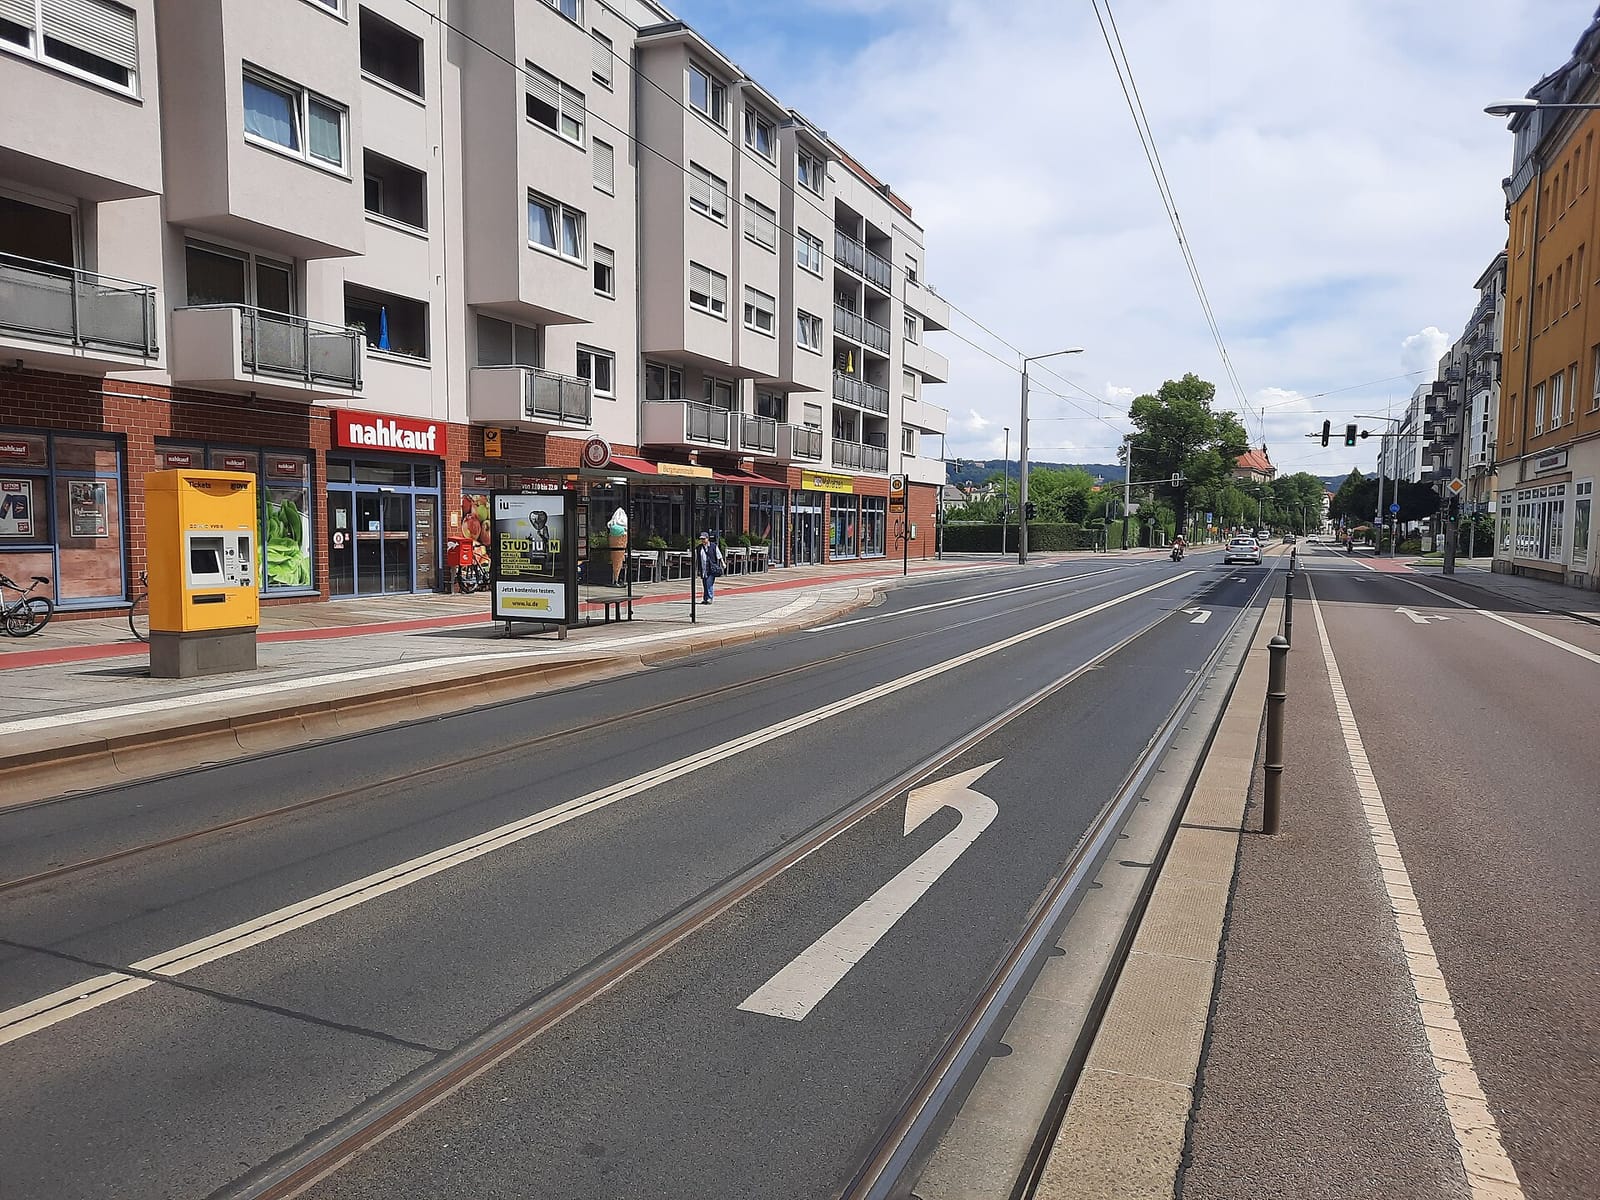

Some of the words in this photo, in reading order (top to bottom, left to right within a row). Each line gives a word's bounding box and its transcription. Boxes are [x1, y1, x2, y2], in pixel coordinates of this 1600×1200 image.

[350, 419, 436, 451] nahkauf
[188, 481, 212, 489] Tickets
[499, 499, 509, 510] iu
